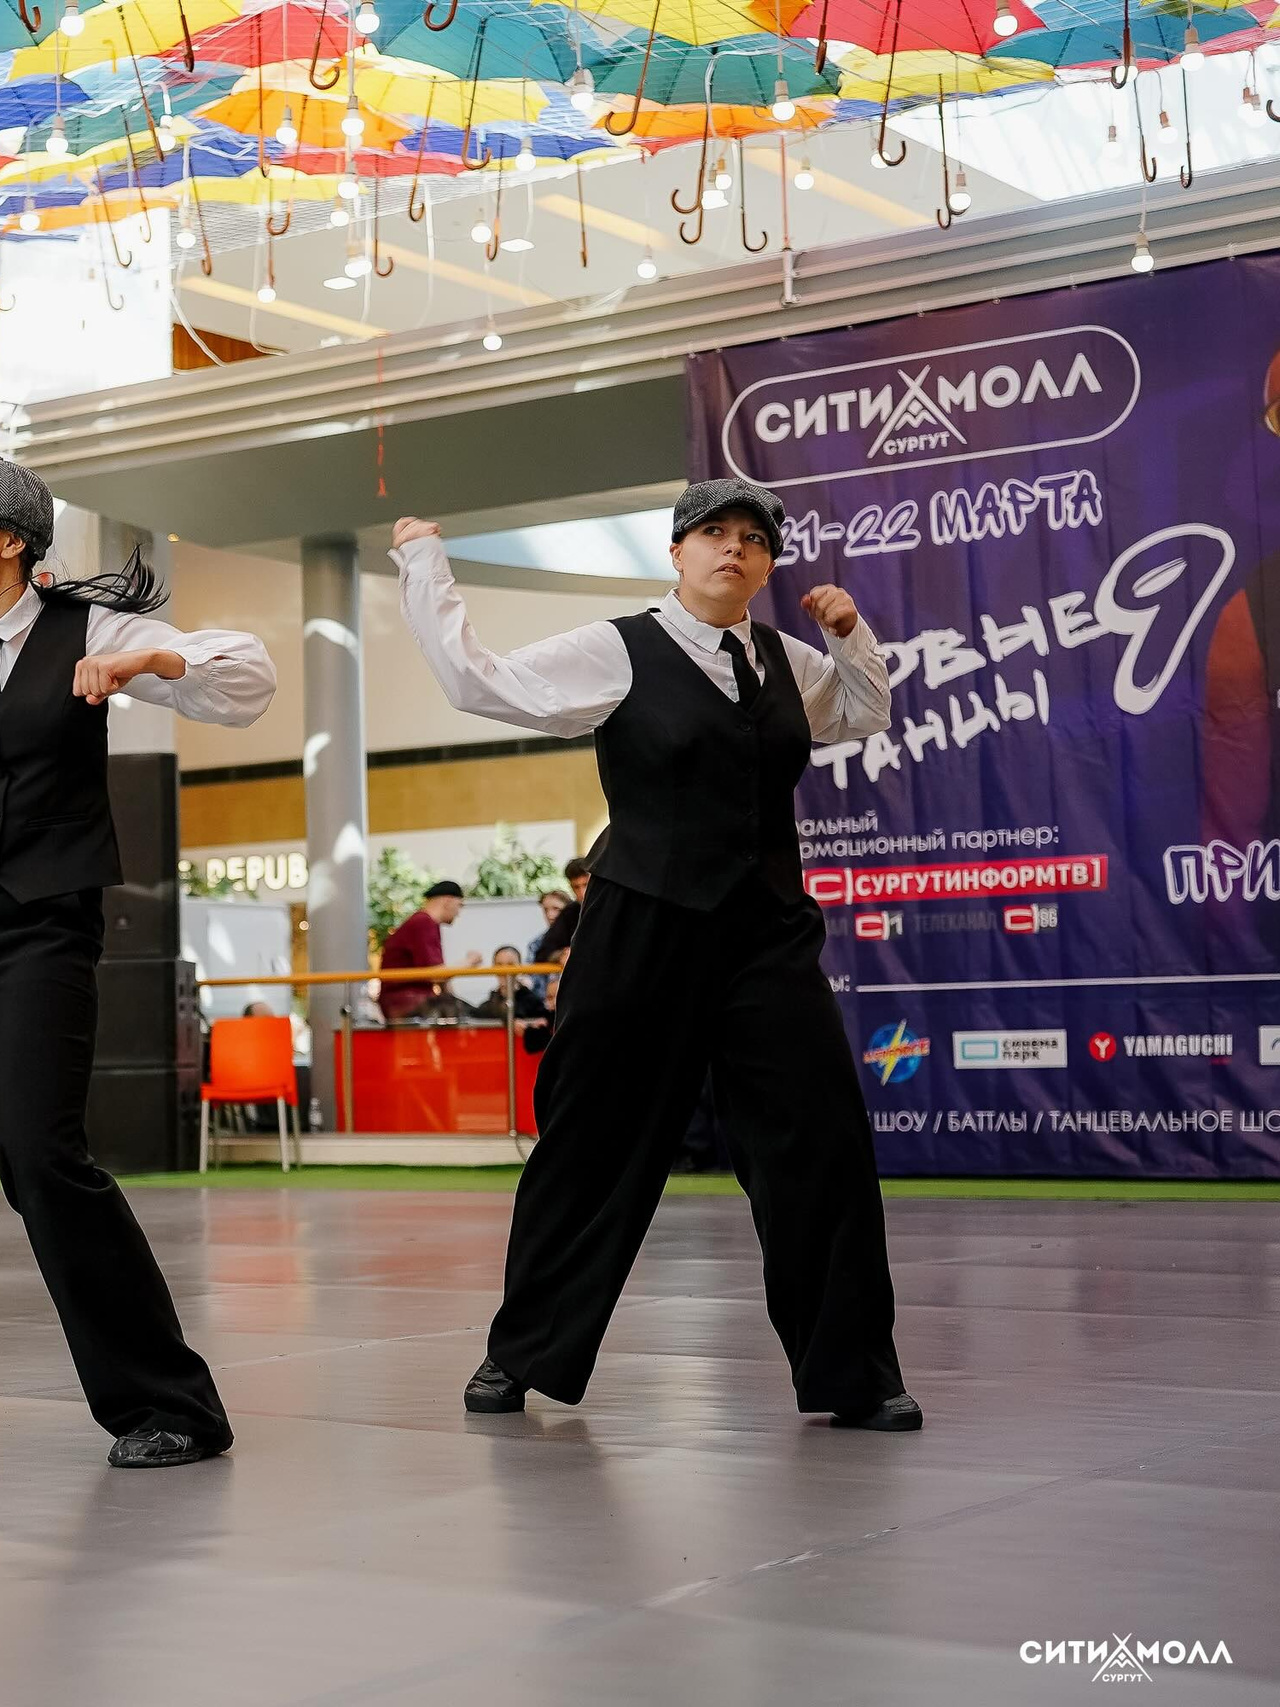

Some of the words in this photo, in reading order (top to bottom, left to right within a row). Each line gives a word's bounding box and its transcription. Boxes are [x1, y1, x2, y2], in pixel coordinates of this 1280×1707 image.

[882, 431, 950, 456] СУРГУТ
[929, 469, 1103, 546] МАРТА
[876, 591, 1106, 690] ОВЫЕ
[810, 668, 1050, 790] ТАНЦЫ
[797, 810, 878, 837] альный
[951, 825, 1060, 852] партнер:
[1123, 1034, 1233, 1057] YAMAGUCHI
[874, 1110, 928, 1132] ШОУ
[1048, 1110, 1233, 1135] ТАНЦЕВАЛЬНОЕ
